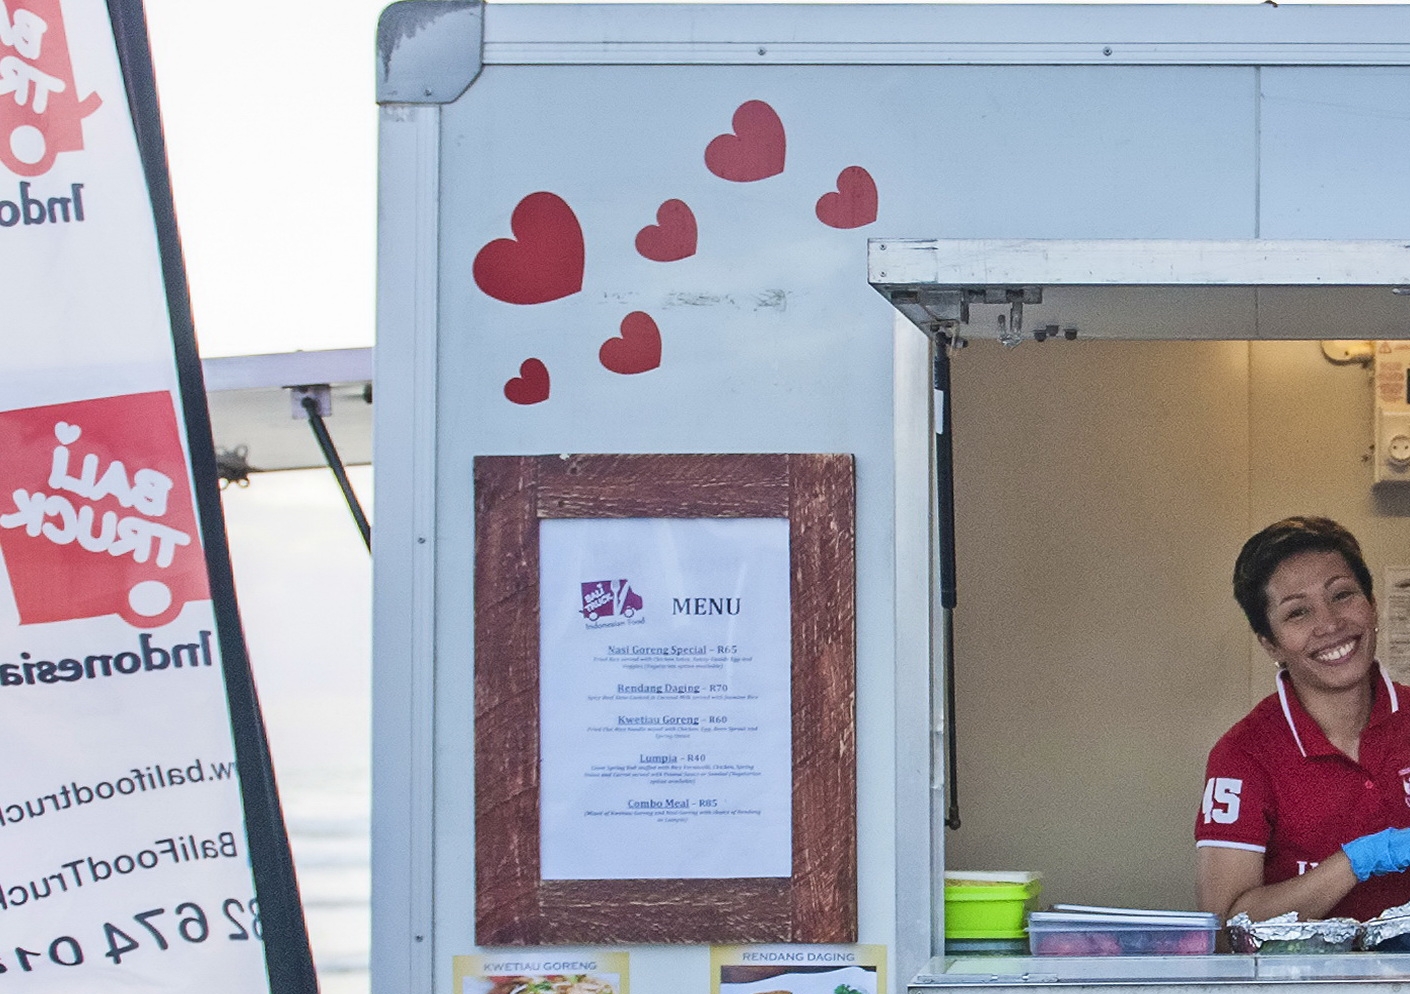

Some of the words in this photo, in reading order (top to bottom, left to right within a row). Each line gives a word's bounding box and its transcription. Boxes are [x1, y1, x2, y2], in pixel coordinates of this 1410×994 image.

[672, 598, 742, 616] MENU
[608, 645, 630, 655] Nasi
[632, 645, 669, 655] Goreng
[671, 645, 706, 656] Special
[717, 645, 738, 654] R65
[617, 684, 663, 694] Rendang
[664, 684, 700, 694] Daging
[709, 684, 728, 692] R70
[618, 715, 660, 725] Kwetiau
[662, 715, 700, 726] Goreng
[709, 715, 728, 724] R60
[639, 754, 677, 764] Lumpia
[687, 754, 706, 762] R40
[628, 799, 663, 809] Combo
[665, 799, 690, 809] Meal
[699, 799, 718, 808] R85
[742, 952, 805, 962] RENDANG
[807, 952, 856, 962] DAGING
[483, 962, 541, 972] KWETIAU
[543, 961, 597, 971] GORENG
